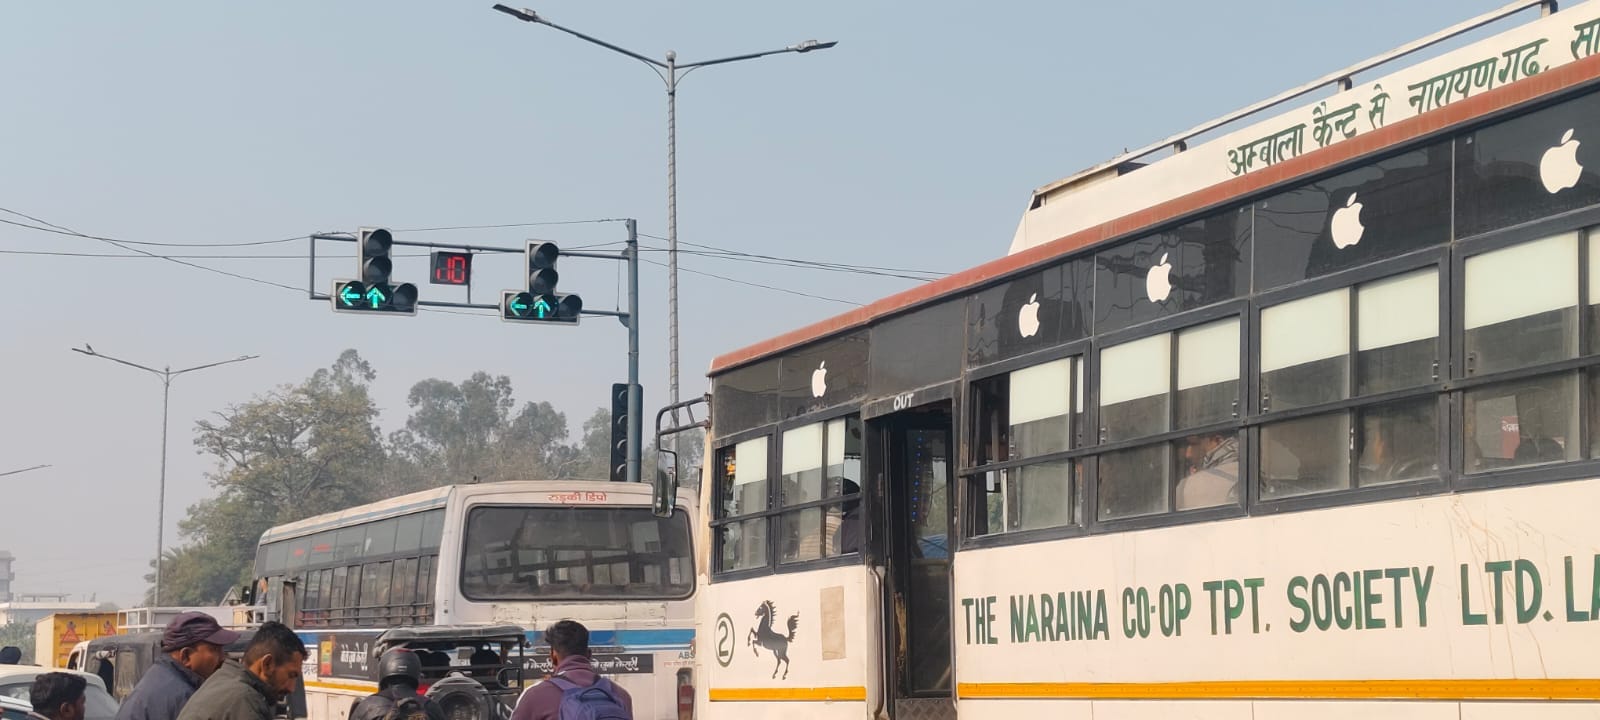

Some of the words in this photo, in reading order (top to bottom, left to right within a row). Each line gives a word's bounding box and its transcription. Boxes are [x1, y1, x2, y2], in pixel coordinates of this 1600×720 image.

[1227, 123, 1307, 175] अम्बाला
[1369, 84, 1391, 129] से
[893, 393, 914, 411] OUT
[962, 596, 998, 645] THE
[1010, 589, 1110, 643] NARAINA
[1203, 578, 1271, 635] TPT.
[1287, 566, 1435, 633] SOCIETY
[1460, 558, 1554, 625] LTD.
[679, 651, 695, 659] ABS
[717, 619, 730, 658] 2
